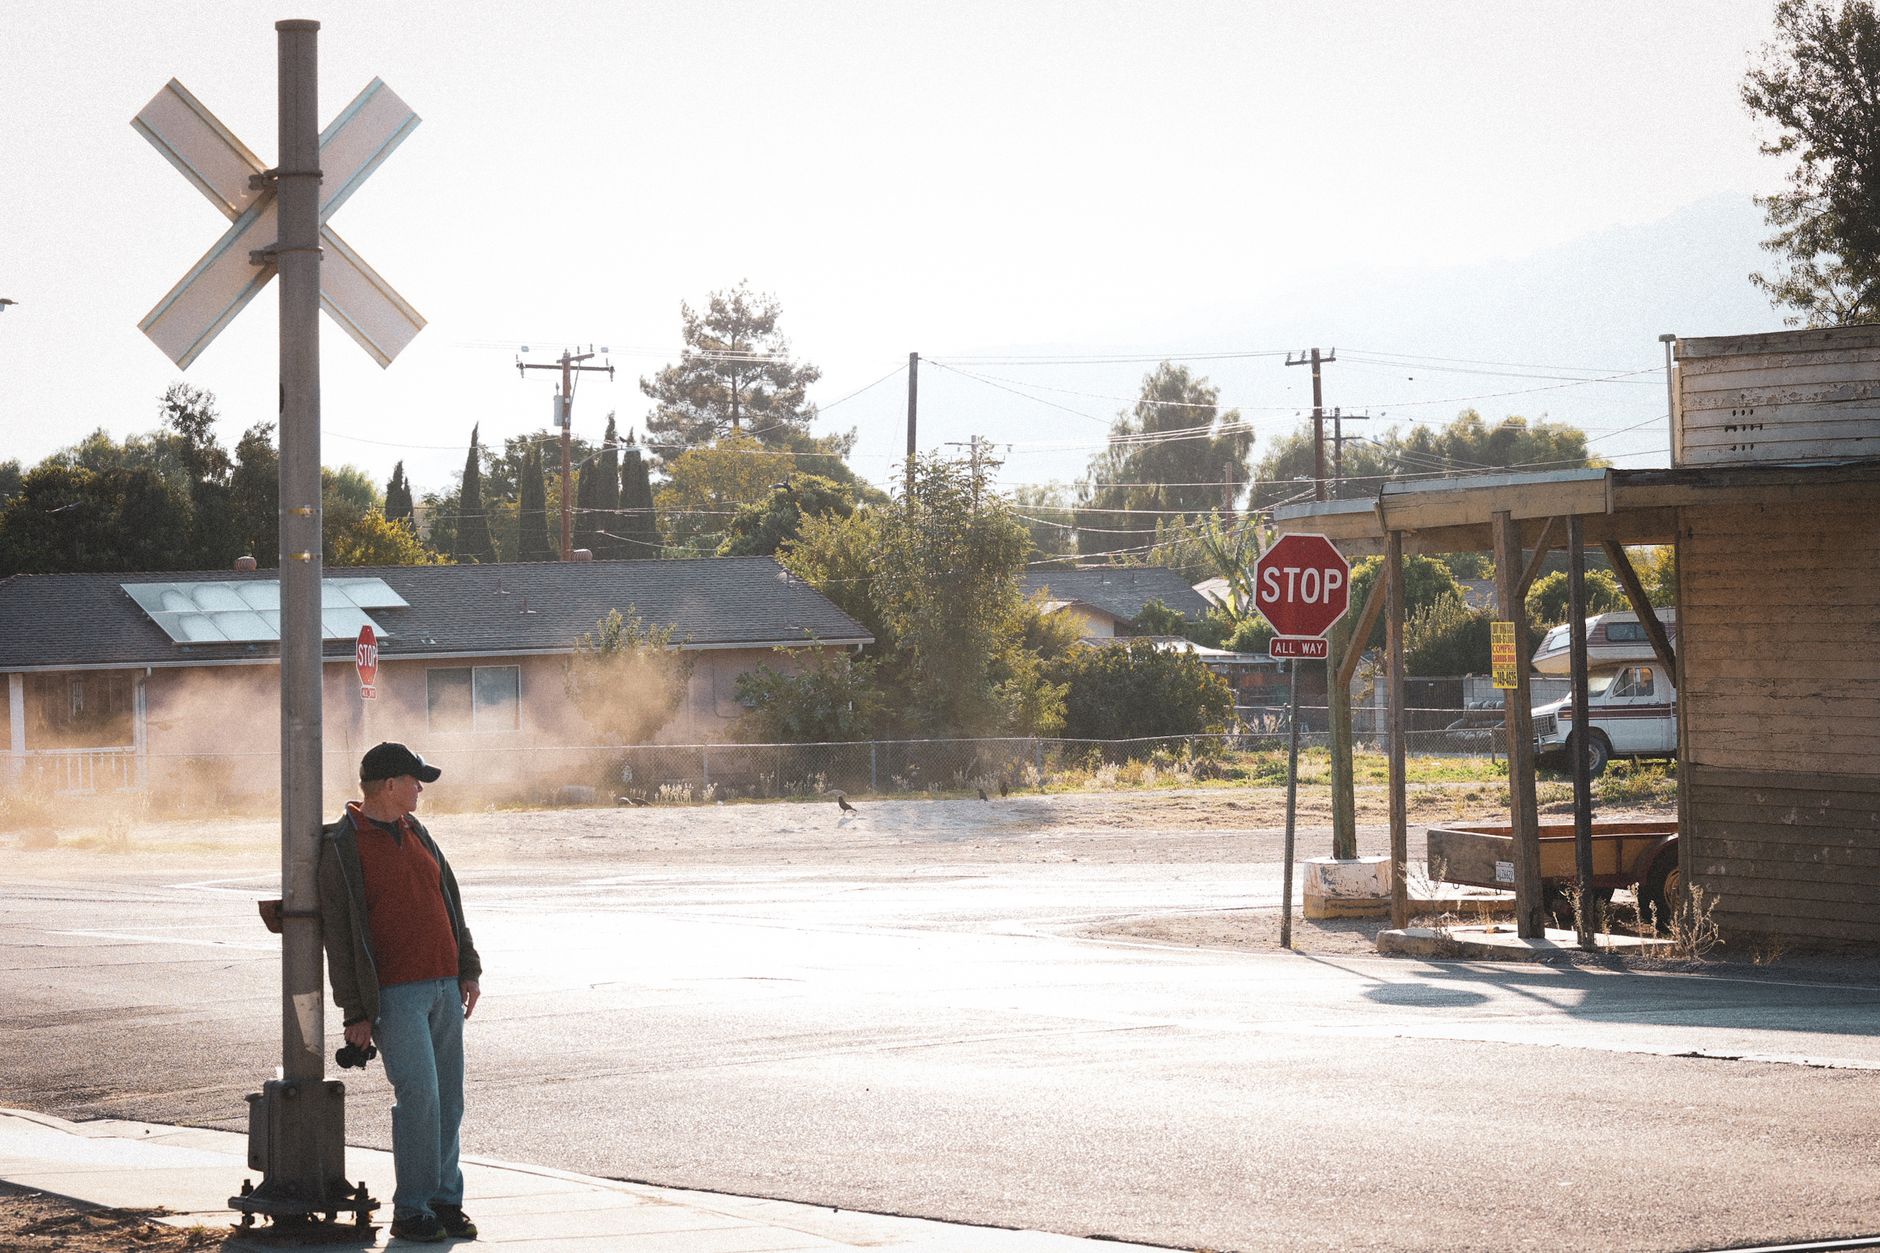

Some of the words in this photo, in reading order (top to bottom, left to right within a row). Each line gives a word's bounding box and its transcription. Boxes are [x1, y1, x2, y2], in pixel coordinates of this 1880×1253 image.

[1262, 567, 1342, 604] STOP
[358, 643, 378, 667] STOP
[1275, 642, 1295, 654] ALL
[1302, 643, 1323, 654] WAY
